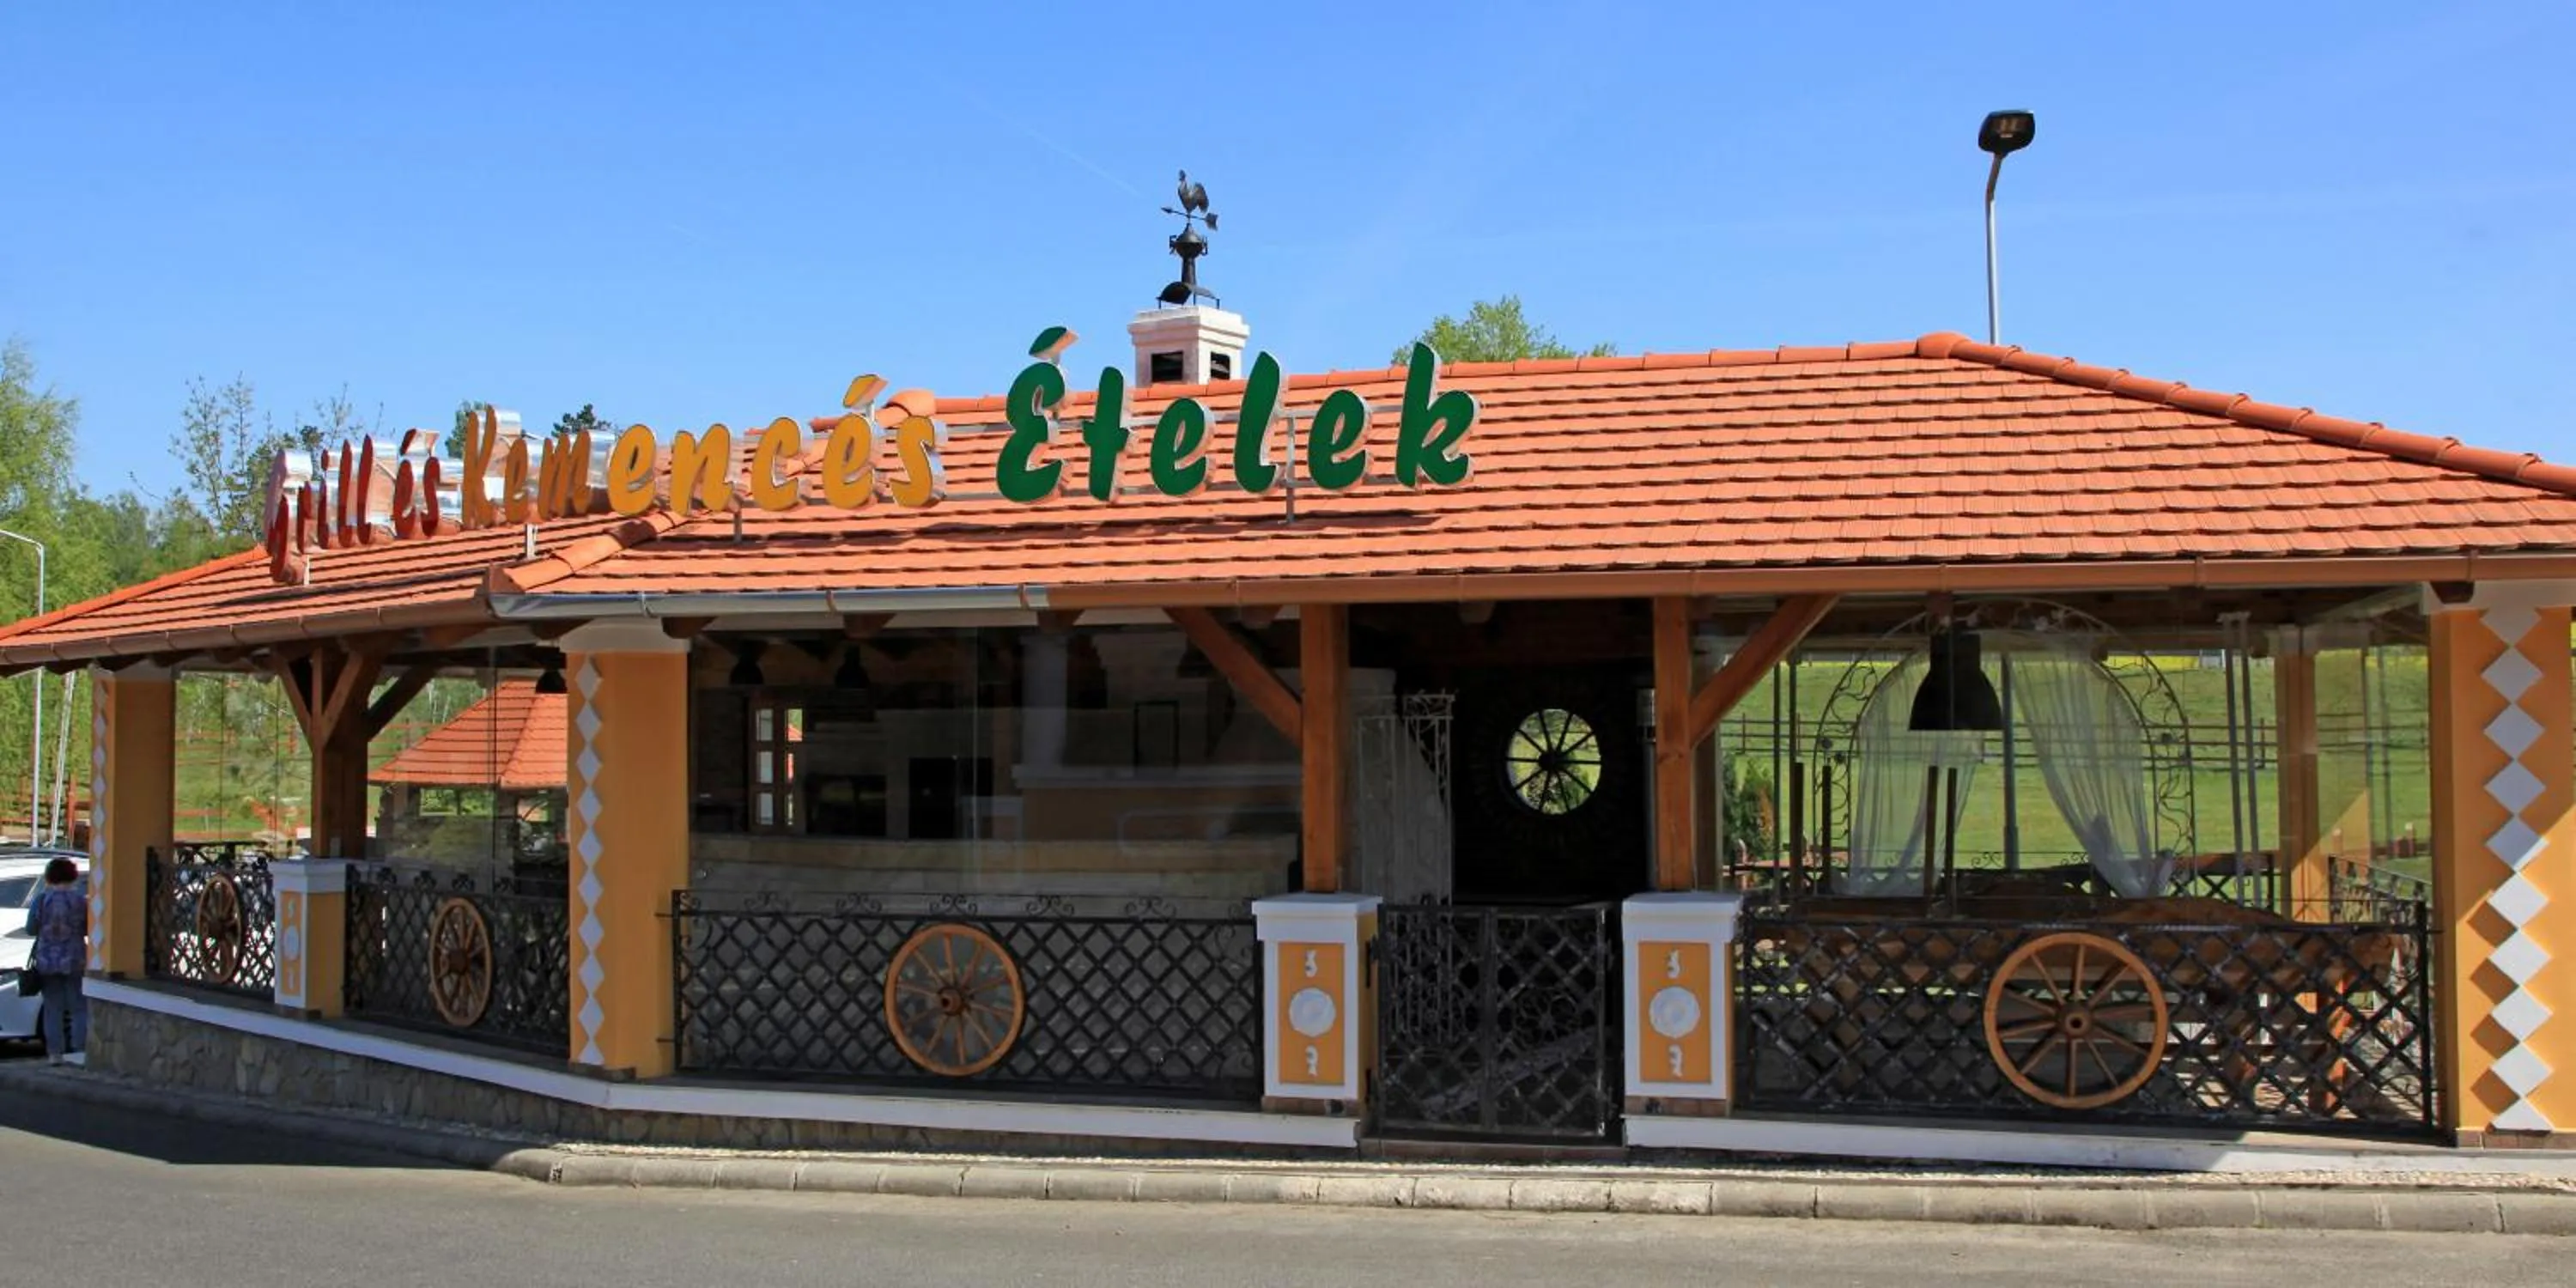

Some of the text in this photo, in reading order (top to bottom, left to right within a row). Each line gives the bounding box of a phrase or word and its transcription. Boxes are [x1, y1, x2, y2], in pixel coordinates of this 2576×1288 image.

[392, 428, 441, 540] és
[461, 374, 938, 529] Kemencés
[995, 325, 1477, 502] Ételek
